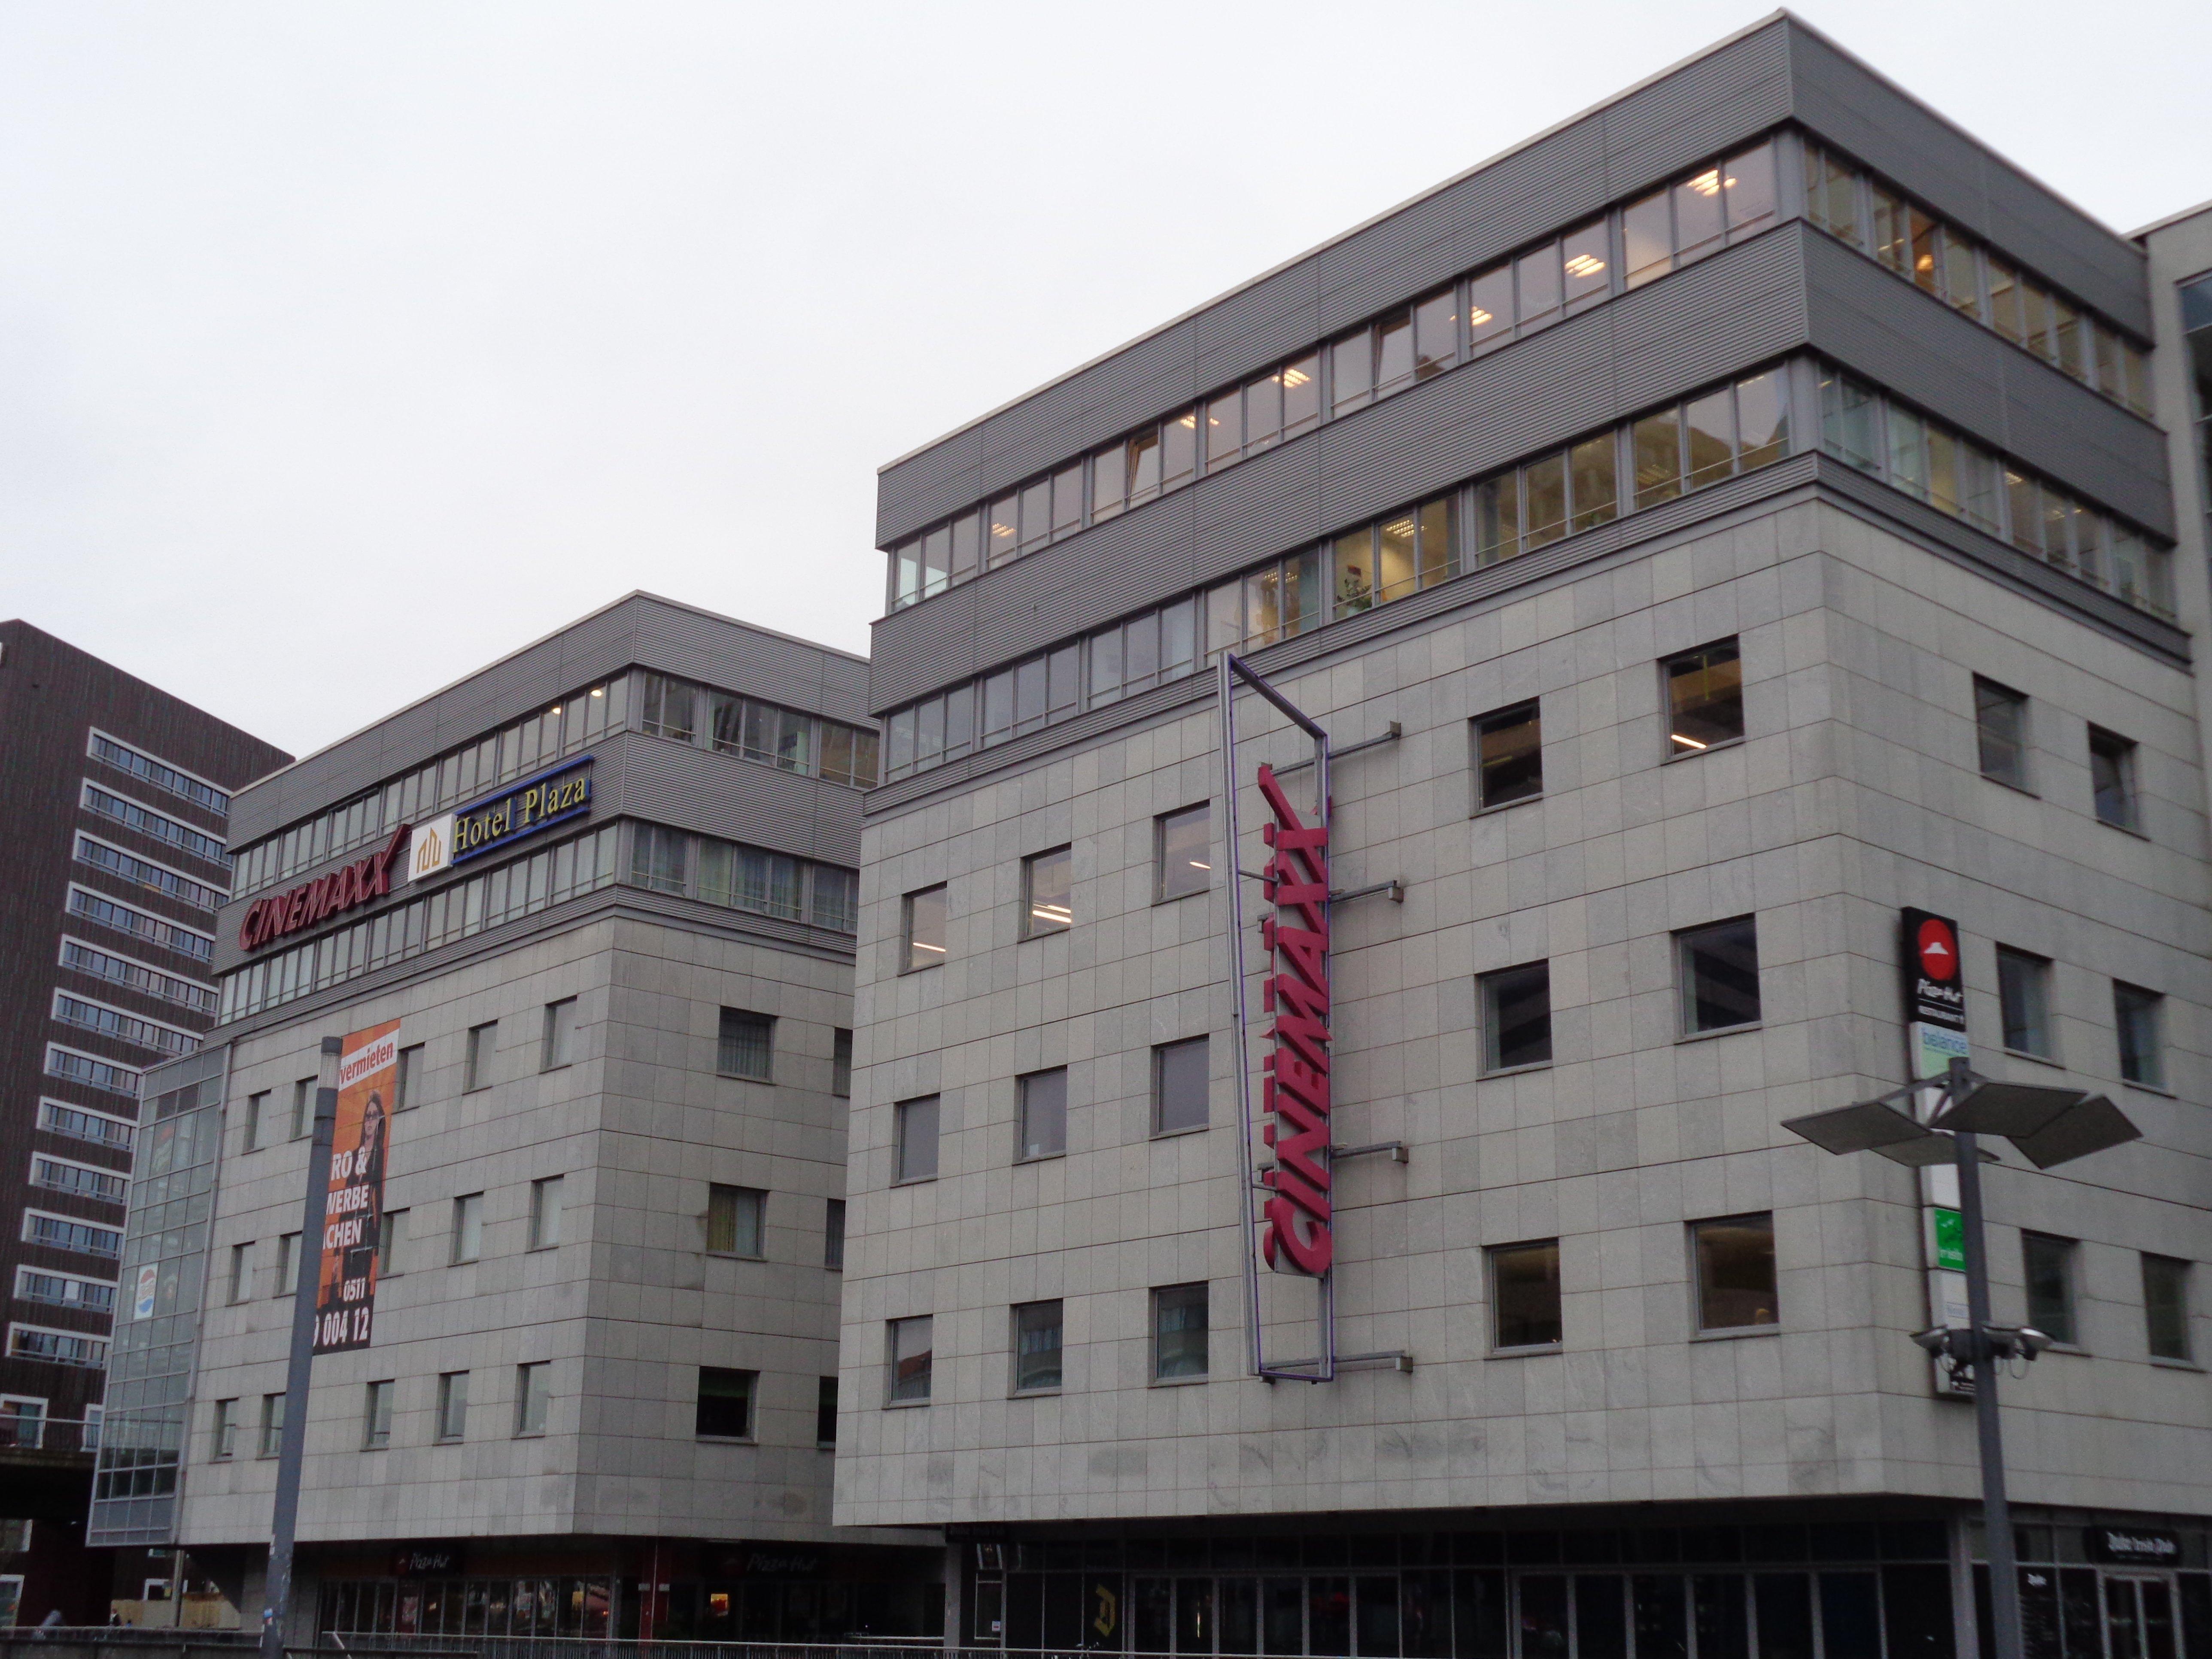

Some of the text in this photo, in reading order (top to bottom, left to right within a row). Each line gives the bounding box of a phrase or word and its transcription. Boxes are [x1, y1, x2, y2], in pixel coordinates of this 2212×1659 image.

[453, 778, 587, 853] Hotel Plaza
[239, 824, 410, 952] CINEMAXX
[1258, 764, 1332, 1273] CINEMAXX
[340, 1042, 393, 1085] vermieten
[331, 1146, 367, 1181] RO &
[326, 1184, 369, 1215] WERBE
[343, 1277, 365, 1302] 0511
[323, 1310, 348, 1346] 004
[353, 1307, 369, 1341] 12
